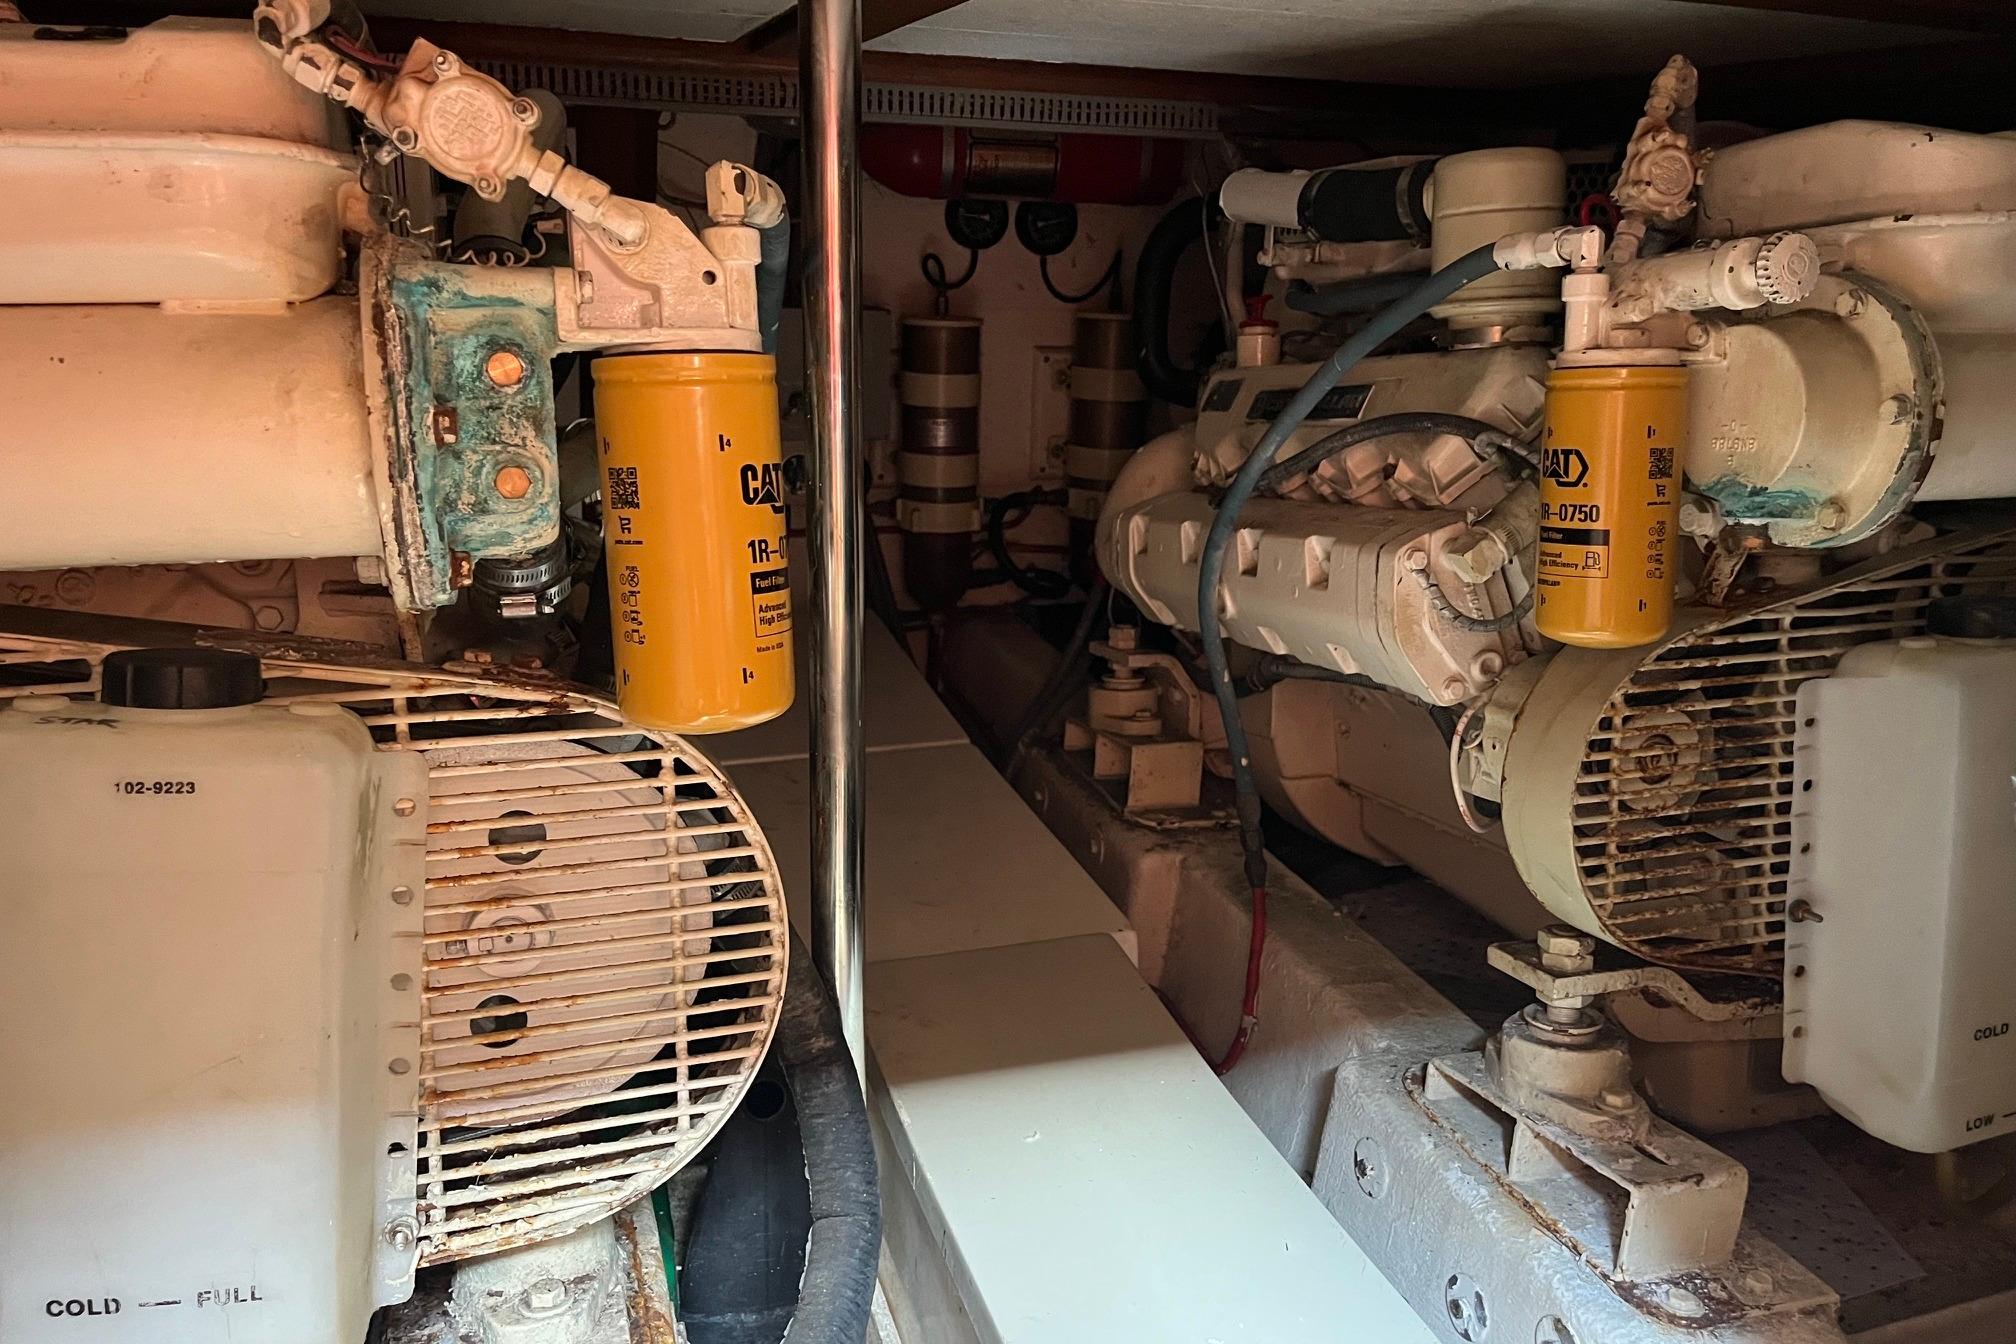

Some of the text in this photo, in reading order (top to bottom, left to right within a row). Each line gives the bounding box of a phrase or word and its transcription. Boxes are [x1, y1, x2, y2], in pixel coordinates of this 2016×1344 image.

[1541, 502, 1600, 523] 1R-0750
[1549, 558, 1579, 571] Efficiency
[755, 577, 772, 589] Fuel
[759, 614, 776, 627] High
[113, 780, 197, 796] 102-9223
[1973, 1023, 2010, 1041] COLD
[1965, 1113, 1995, 1132] LOW
[45, 1285, 263, 1318] COLD FULL
